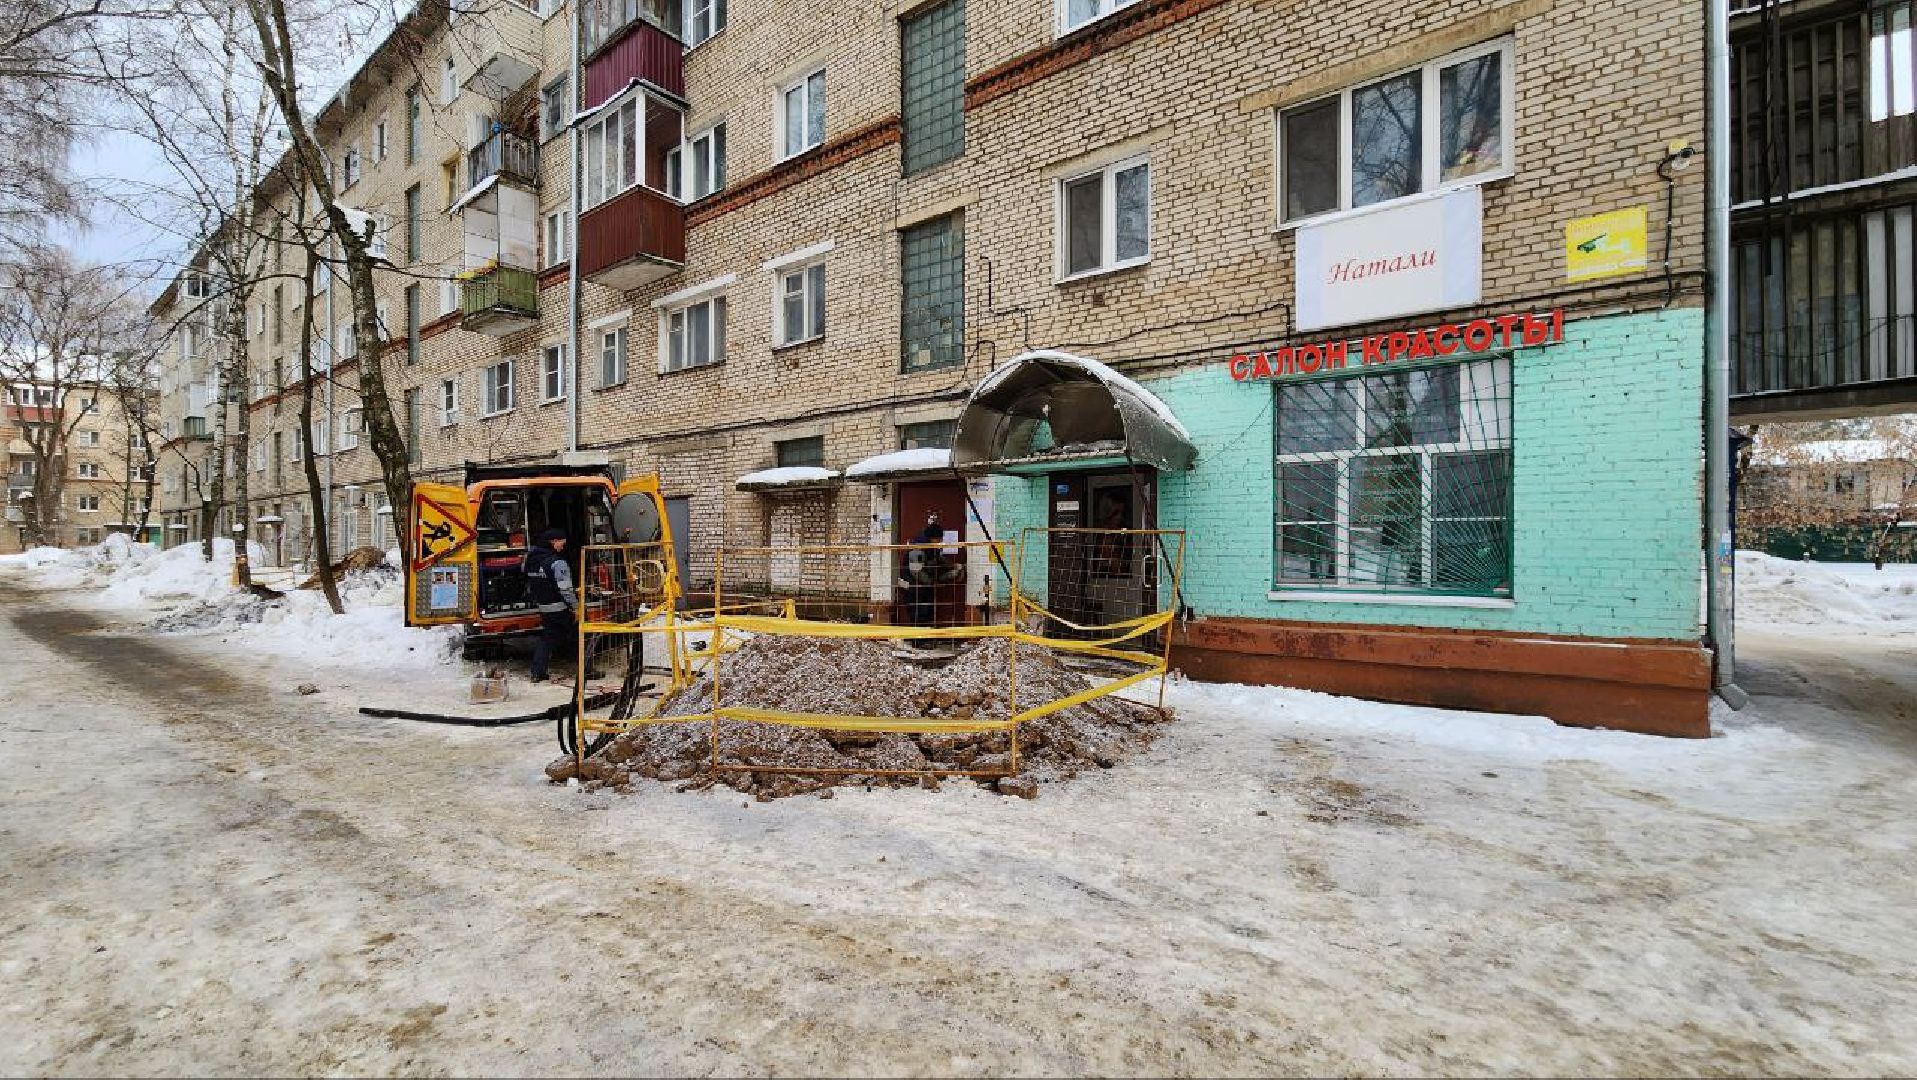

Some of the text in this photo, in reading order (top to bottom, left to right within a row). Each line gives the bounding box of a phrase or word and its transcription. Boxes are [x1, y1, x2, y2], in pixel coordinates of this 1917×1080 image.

[1328, 249, 1436, 284] Натали
[1228, 309, 1565, 380] САЛОН КРАСОТЫ
